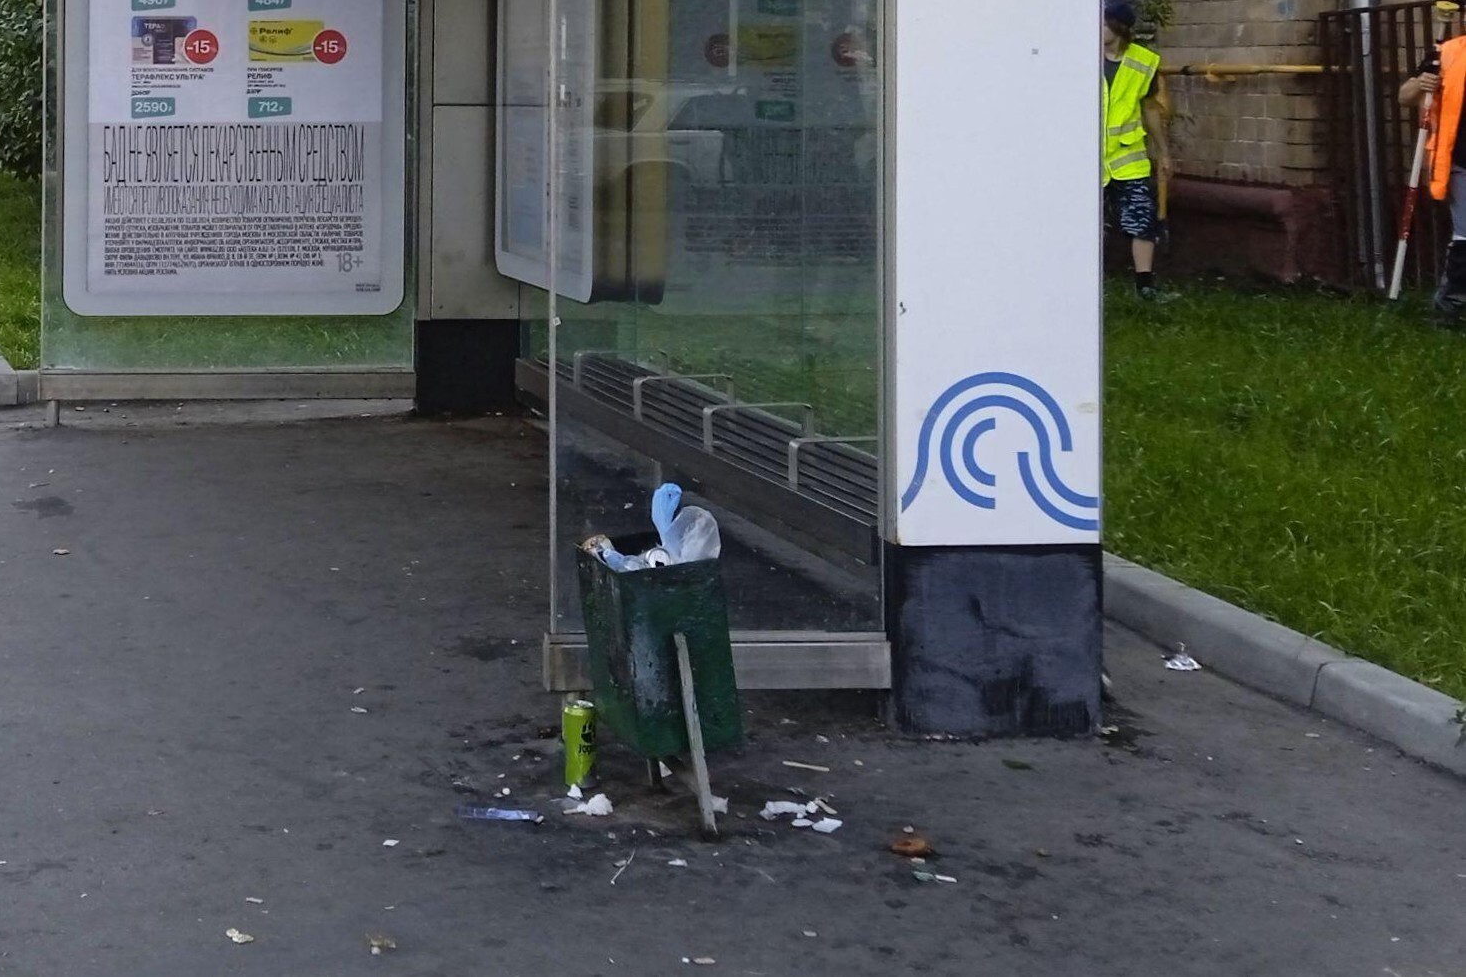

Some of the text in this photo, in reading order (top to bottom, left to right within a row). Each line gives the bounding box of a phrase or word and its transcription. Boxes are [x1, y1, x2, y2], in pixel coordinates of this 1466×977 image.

[104, 124, 364, 187] БАД НЕ ЯВЛЯЕТСЯ ЛЕКАРСТВЕННЫМ СРЕДСТВОМ
[336, 252, 364, 273] 18+
